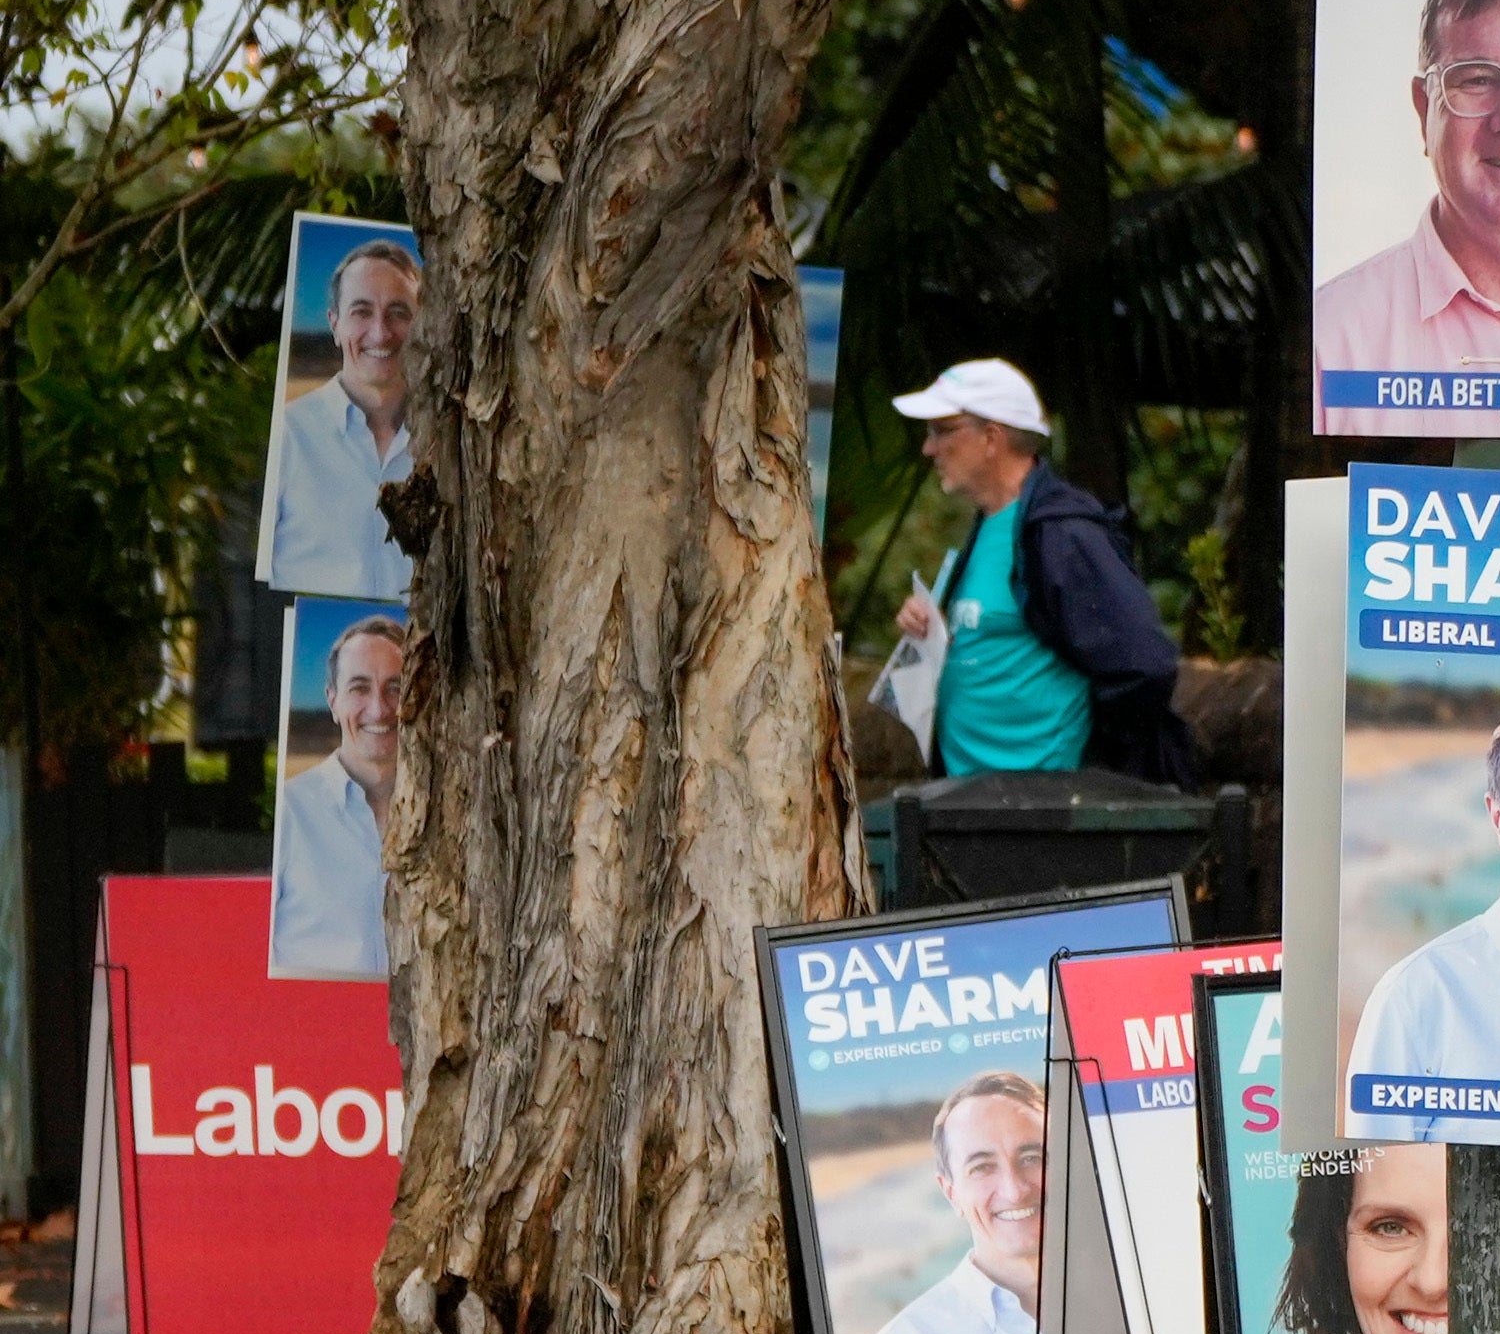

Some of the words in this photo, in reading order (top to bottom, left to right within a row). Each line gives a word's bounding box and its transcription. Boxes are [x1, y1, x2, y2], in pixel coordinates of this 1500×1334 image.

[1378, 378, 1423, 406] FOR
[1427, 379, 1444, 406] A
[1382, 619, 1495, 648] LIBERAL
[798, 936, 949, 992] DAVE
[803, 967, 1048, 1043] SHARM
[833, 1040, 942, 1065] EXPERIENCED
[1244, 1159, 1374, 1180] INDEPENDENT
